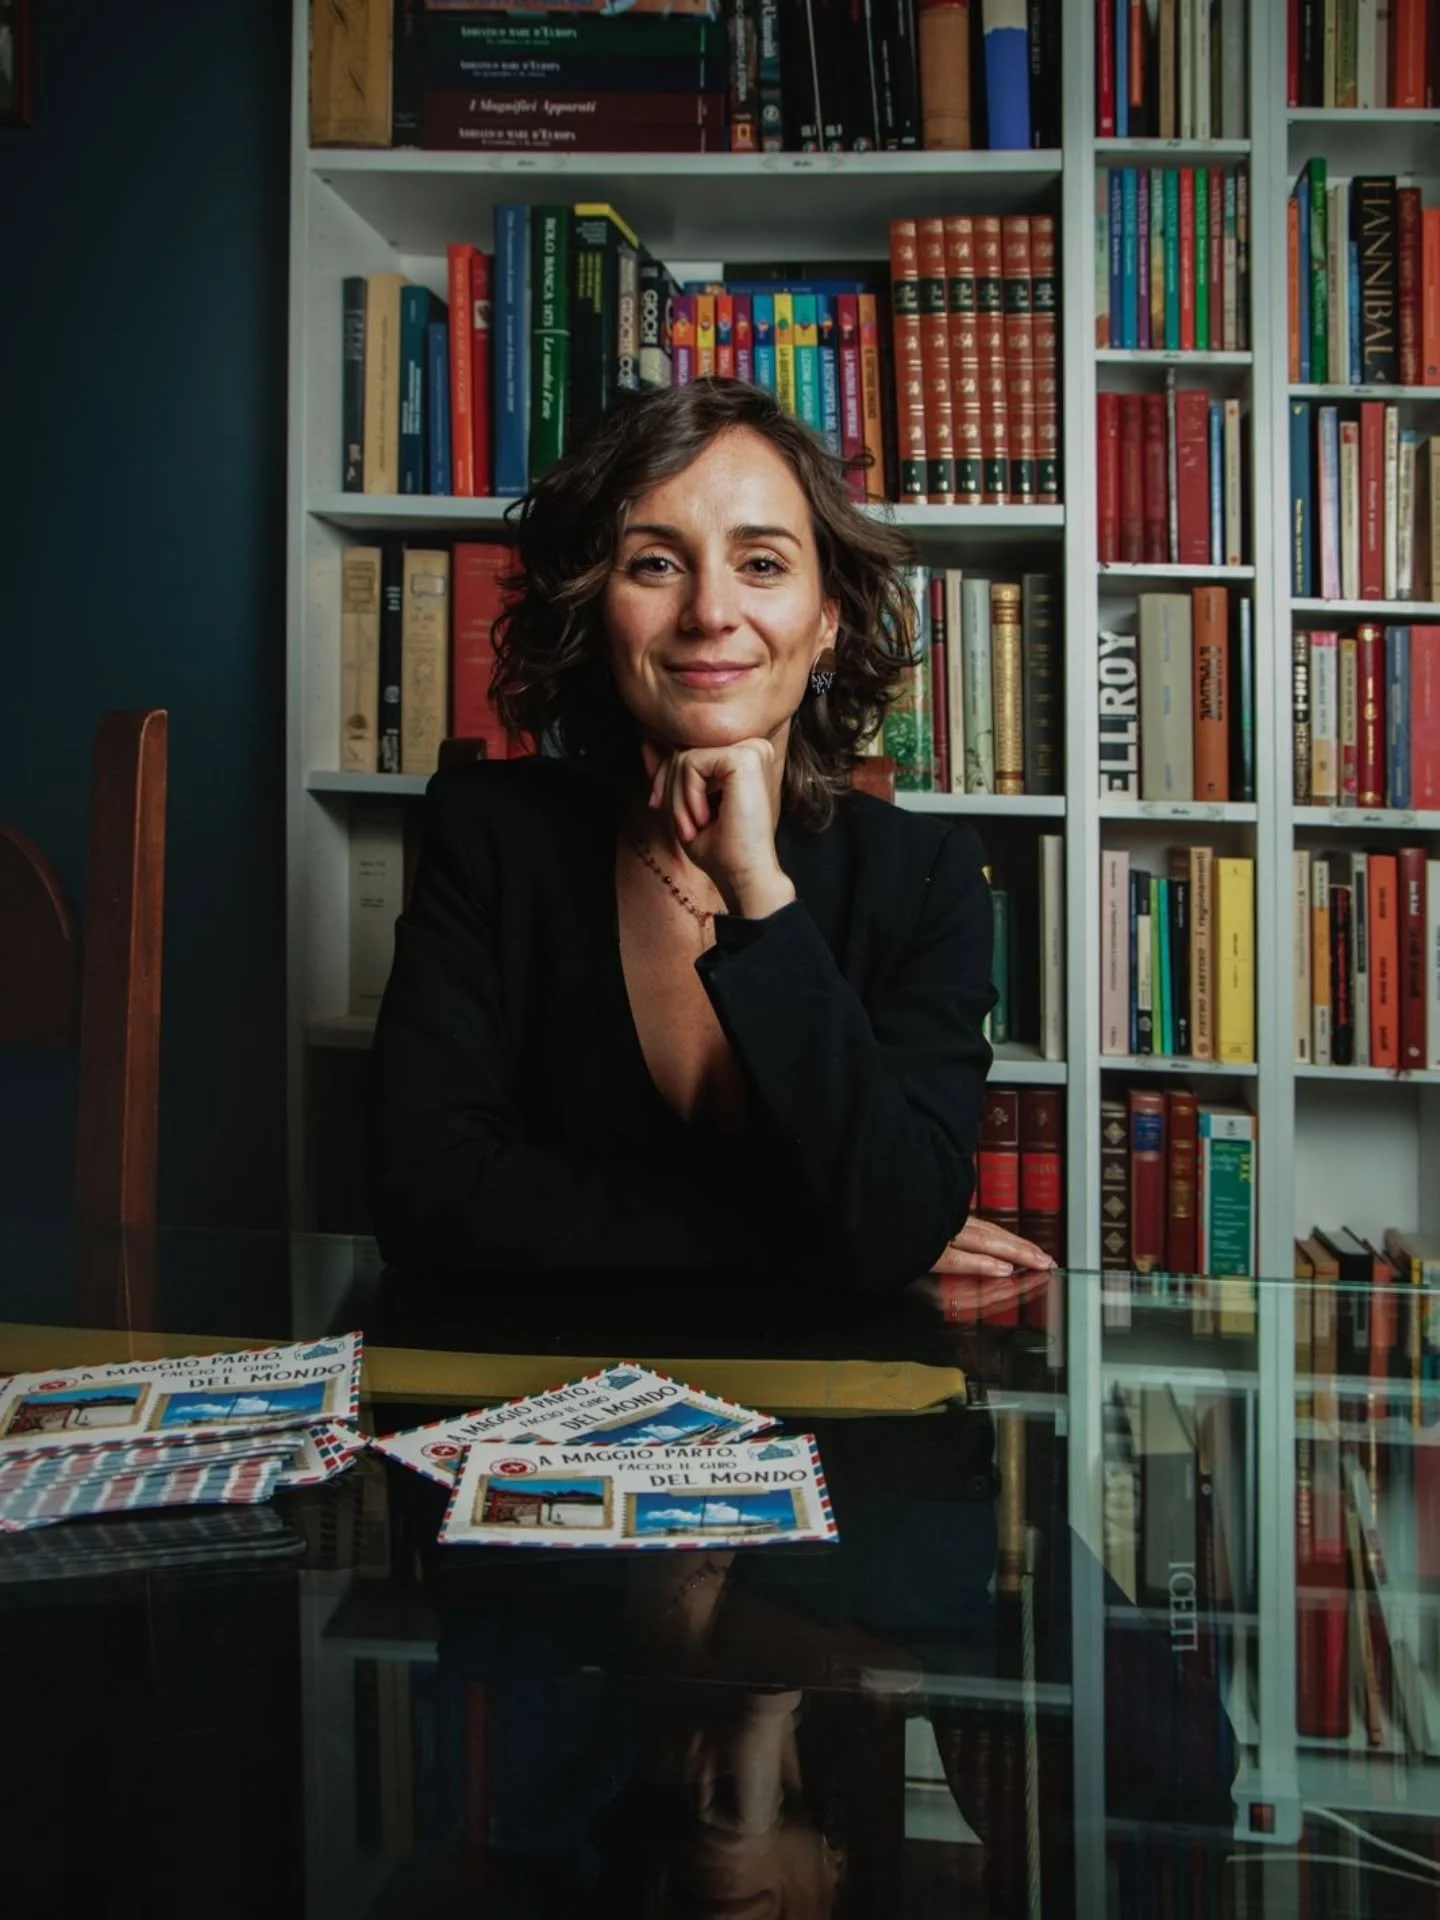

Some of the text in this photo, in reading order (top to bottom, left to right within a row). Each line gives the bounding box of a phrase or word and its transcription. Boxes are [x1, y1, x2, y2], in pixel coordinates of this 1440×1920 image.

[542, 255, 556, 300] BANCA
[1362, 181, 1394, 364] HANNIBAL
[642, 289, 659, 344] GIOCHI
[1098, 630, 1138, 800] ELLROY
[81, 1351, 283, 1381] A MAGGIO PARTO,
[160, 1365, 216, 1379] FACCIO
[242, 1361, 281, 1372] GIRO
[189, 1363, 346, 1388] DEL MONDO
[461, 1406, 532, 1437] MAGGIO
[534, 1386, 596, 1410] PARTO,
[519, 1408, 564, 1427] FACCIO
[580, 1393, 611, 1411] GIRO
[559, 1386, 679, 1433] DEL MONDO
[539, 1447, 738, 1467] A MAGGIO PARTO,
[618, 1462, 673, 1472] FACCIO
[699, 1461, 738, 1471] GIRO
[650, 1468, 808, 1488] DEL MONDO
